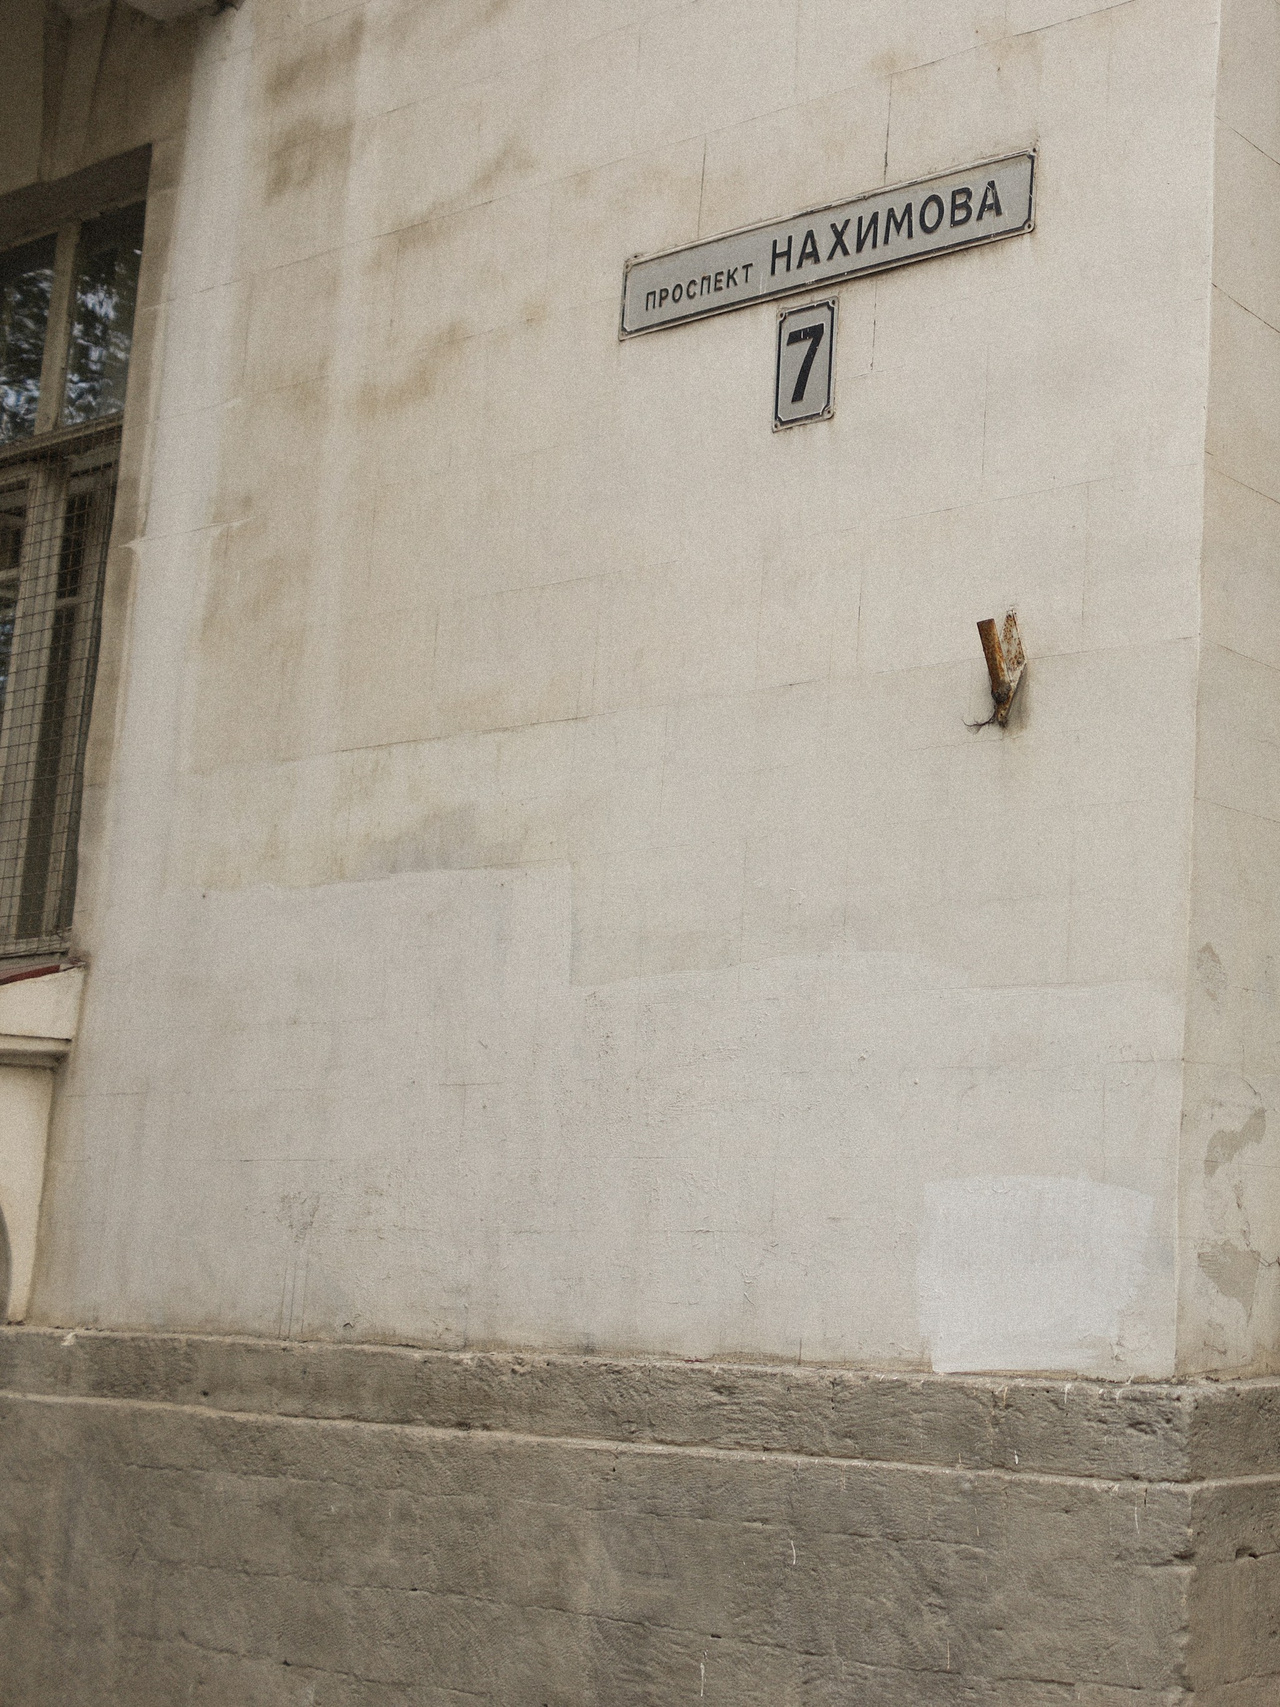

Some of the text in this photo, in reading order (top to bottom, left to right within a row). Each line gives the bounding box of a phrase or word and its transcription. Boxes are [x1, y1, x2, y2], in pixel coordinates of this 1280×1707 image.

[645, 180, 1003, 311] ПРОСПЕКТ НАХИМОВА
[786, 323, 825, 404] 7
